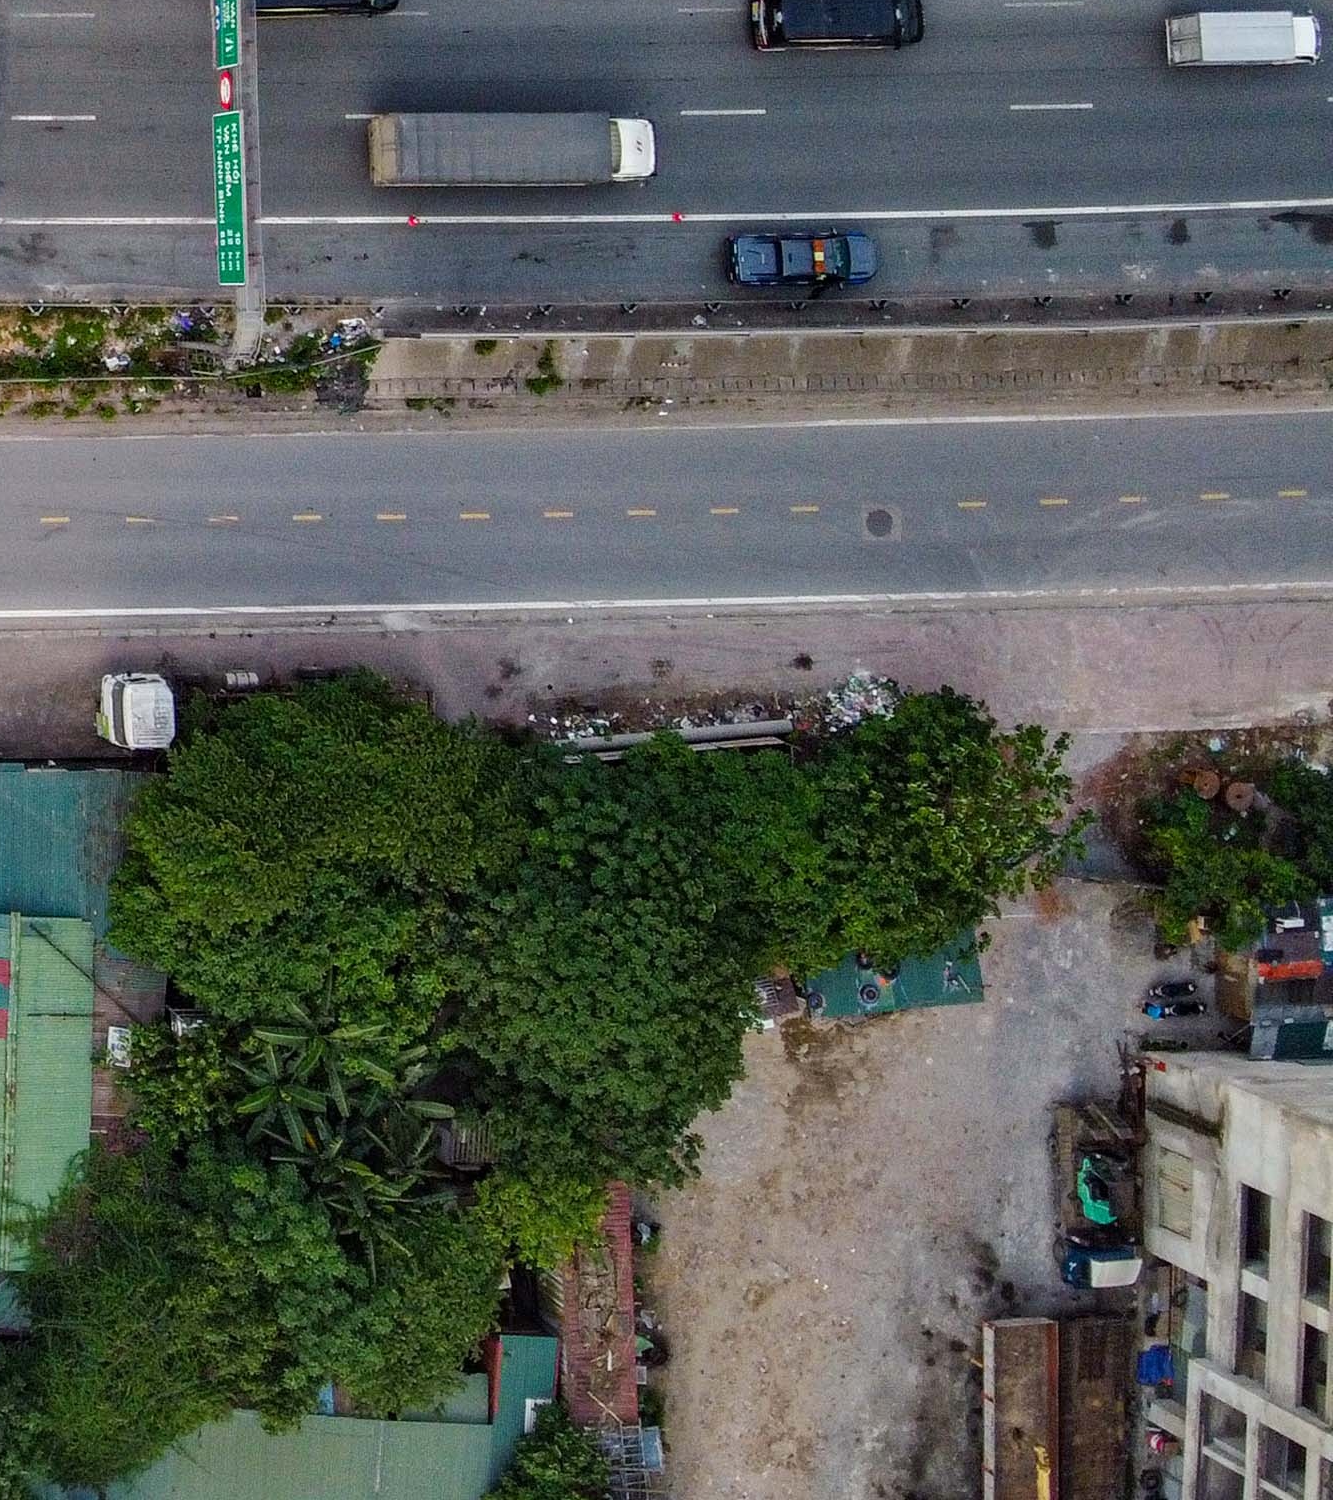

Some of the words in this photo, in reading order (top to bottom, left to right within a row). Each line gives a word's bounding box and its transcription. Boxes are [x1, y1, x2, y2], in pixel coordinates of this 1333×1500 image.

[234, 231, 241, 246] 10
[220, 251, 226, 271] km
[228, 251, 233, 271] km
[235, 251, 241, 271] km
